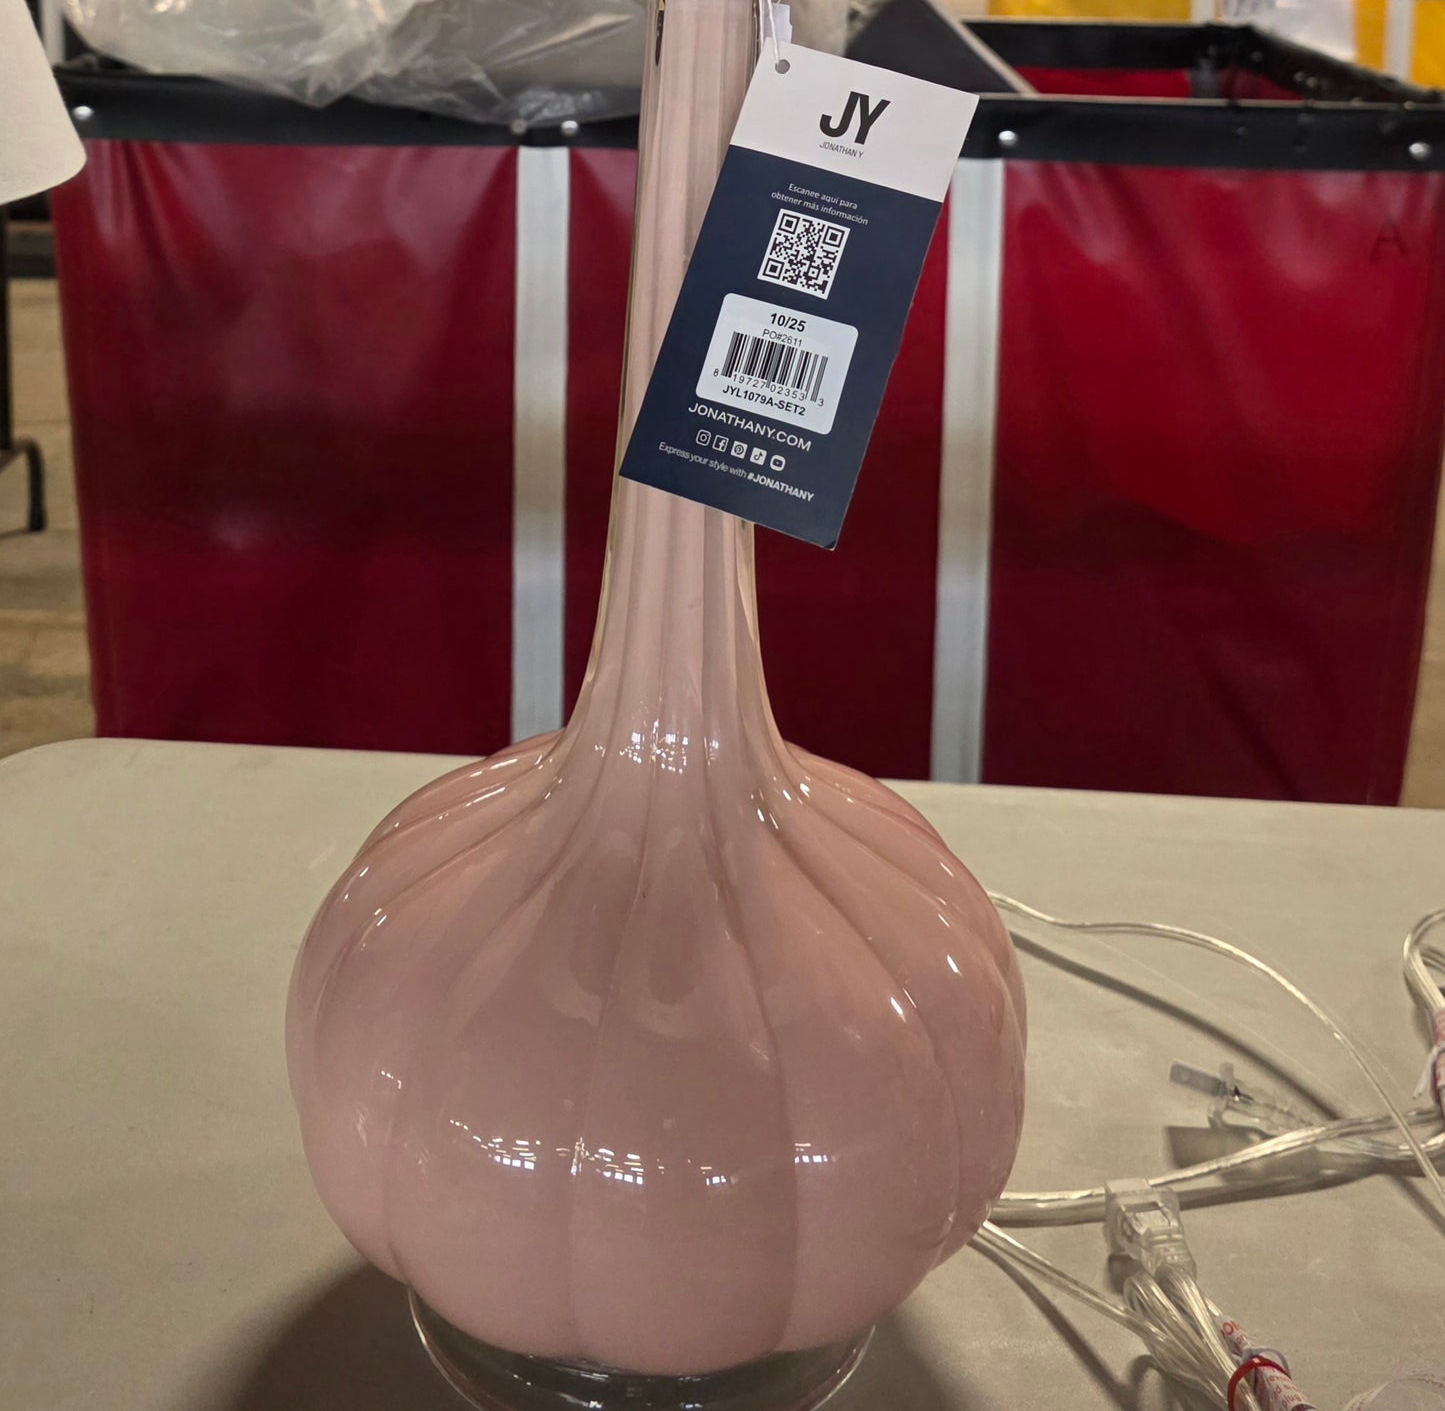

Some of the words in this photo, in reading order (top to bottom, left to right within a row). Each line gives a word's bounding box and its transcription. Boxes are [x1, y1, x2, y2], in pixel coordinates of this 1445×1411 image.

[819, 91, 891, 145] JY
[819, 141, 857, 157] JONATHAN
[856, 151, 864, 159] Y
[771, 191, 802, 205] obtener
[803, 200, 819, 211] más
[820, 205, 869, 226] información
[788, 183, 820, 199] Escanee
[821, 193, 840, 205] aquí
[839, 199, 858, 210] para
[762, 328, 802, 347] PO#2611
[770, 312, 807, 333] 10/25
[713, 368, 720, 378] 8
[818, 397, 825, 407] 3
[722, 385, 806, 416] JYL1079A-SET2
[688, 402, 812, 452] JONATHANY.COM
[658, 441, 691, 461] Express
[690, 453, 709, 465] your
[709, 459, 729, 473] style
[729, 466, 747, 479] with
[747, 472, 815, 502] #JONATHANY
